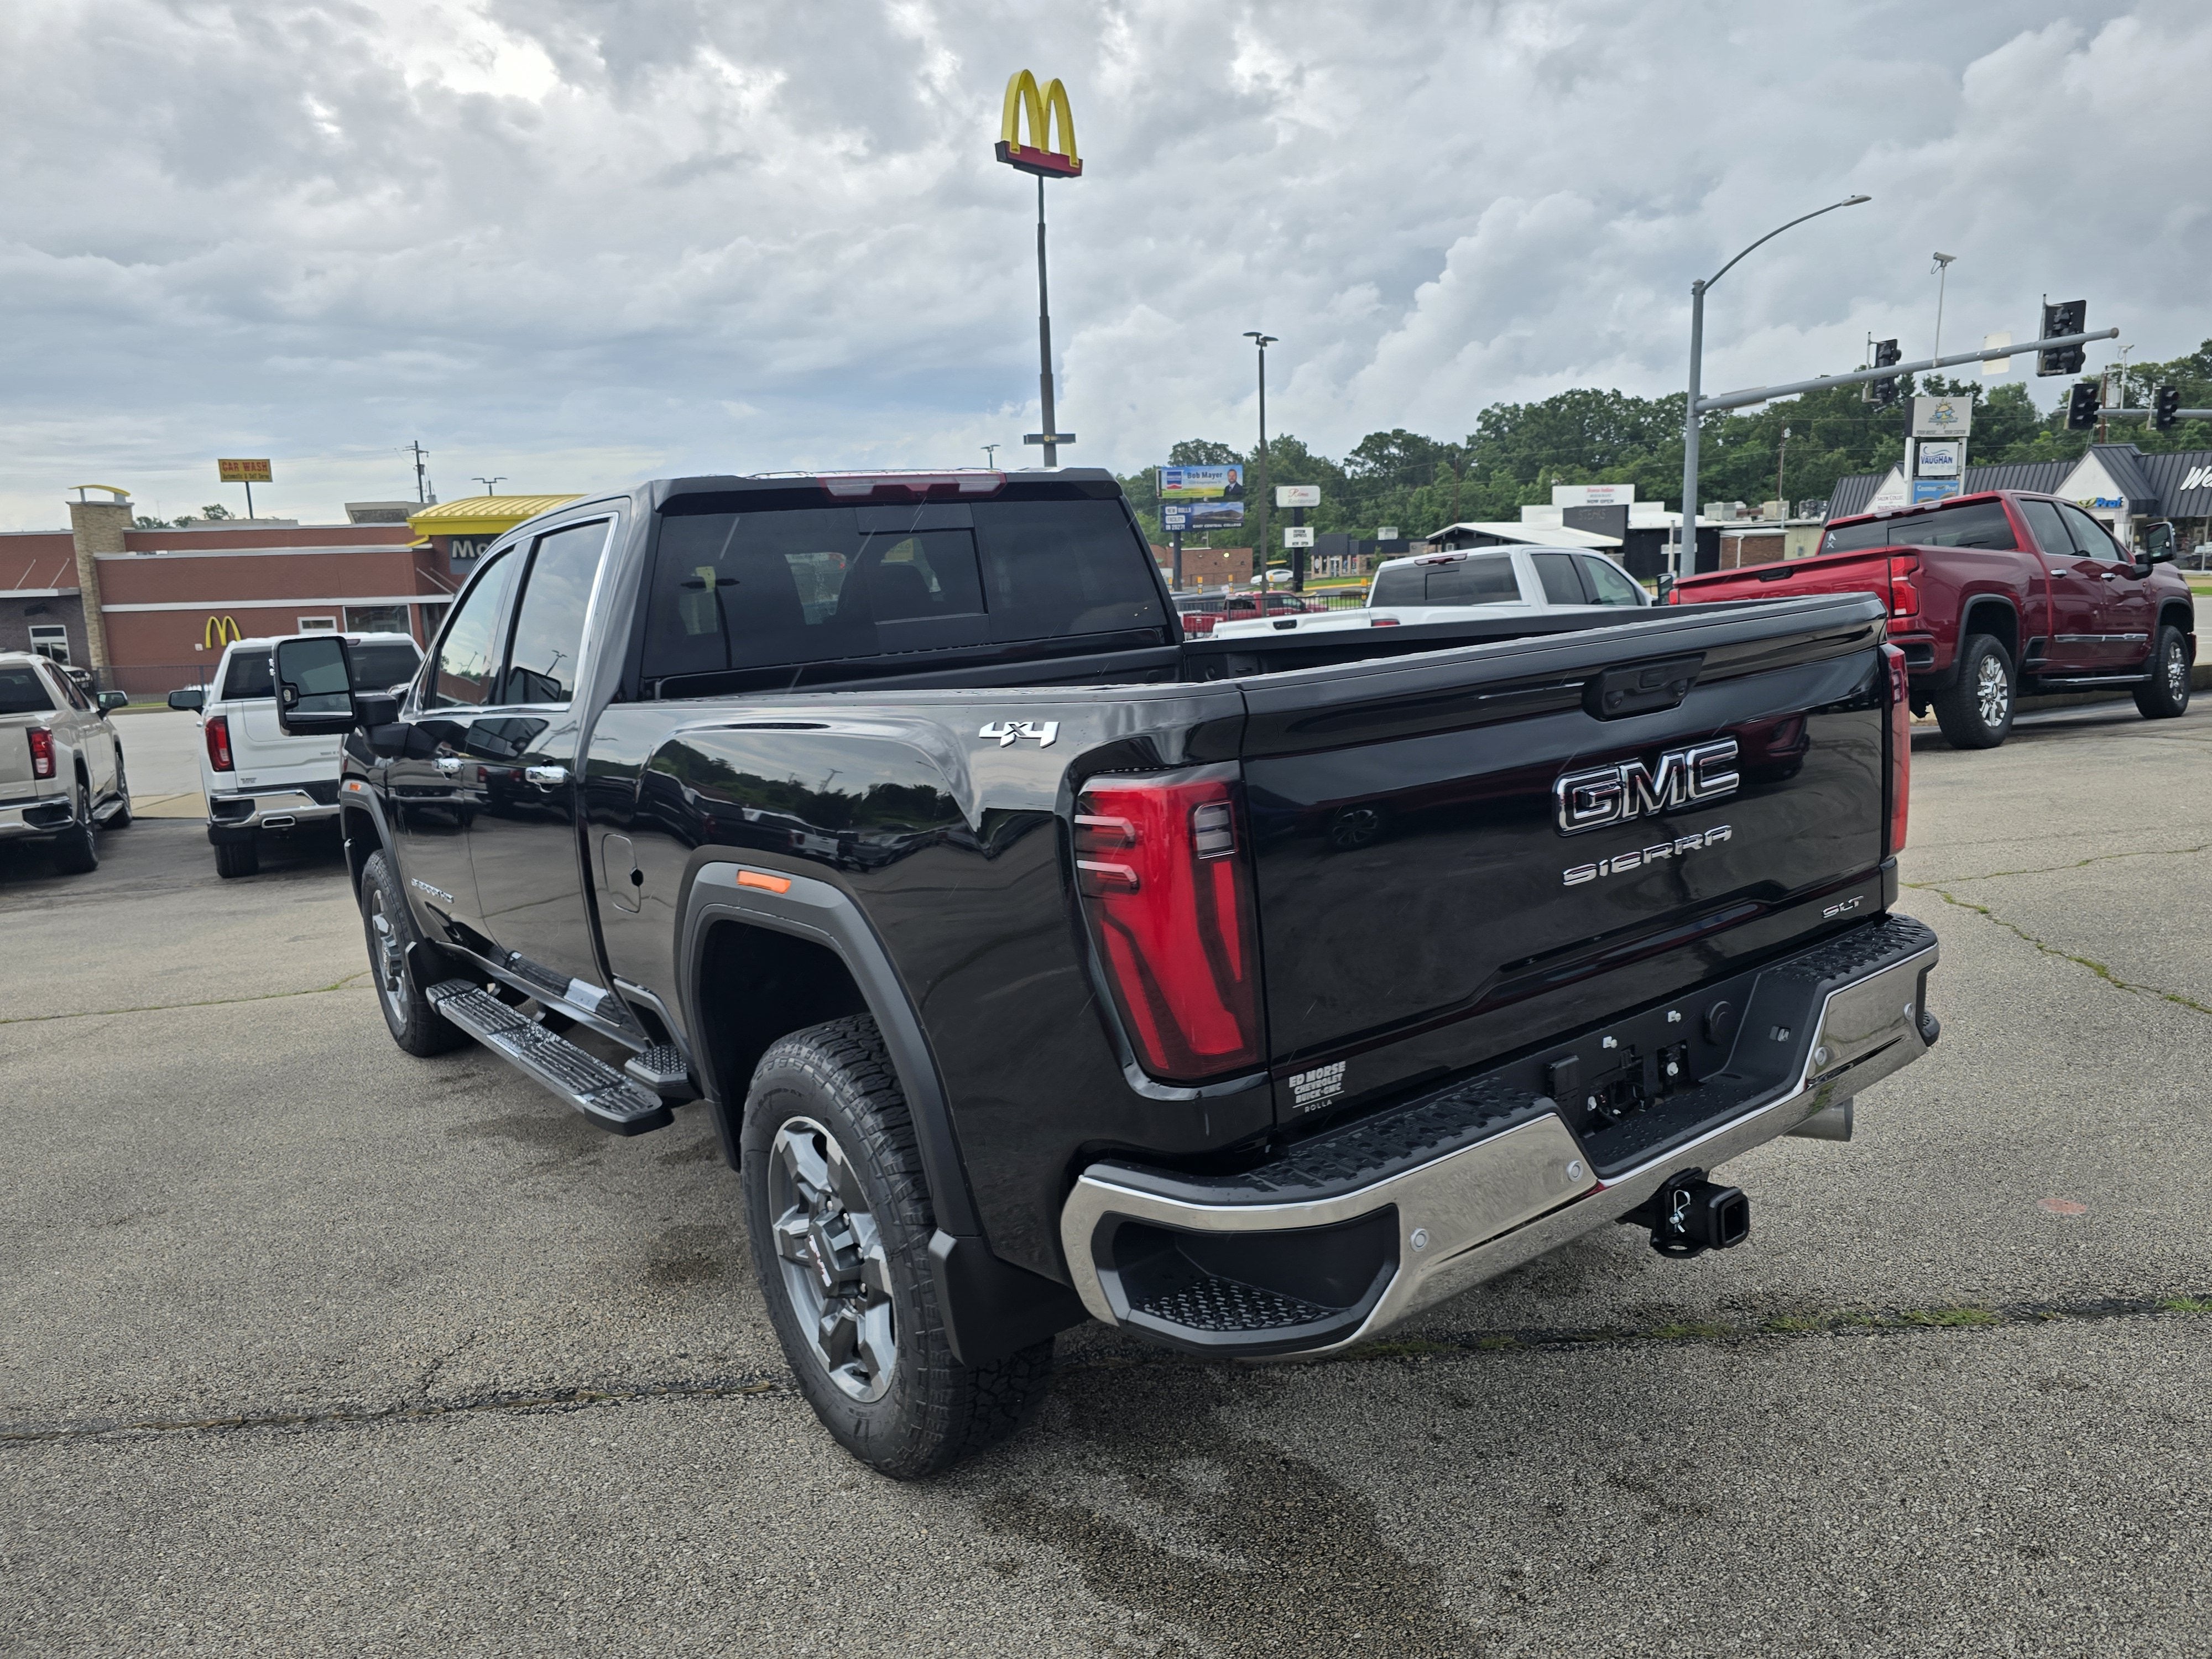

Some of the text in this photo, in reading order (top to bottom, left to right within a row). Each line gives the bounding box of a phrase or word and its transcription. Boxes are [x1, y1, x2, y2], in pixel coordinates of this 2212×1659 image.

[222, 461, 268, 472] CAR WASH
[1921, 456, 1953, 464] VAUGHAN
[2096, 496, 2122, 508] Prof
[1552, 737, 1740, 837] GMC
[1563, 825, 1733, 886] SIERRA
[1823, 895, 1864, 918] SLT
[1288, 1061, 1345, 1088] ED MORSE
[1294, 1073, 1343, 1095] CHEVROLET
[1305, 1099, 1333, 1113] ROLLA
